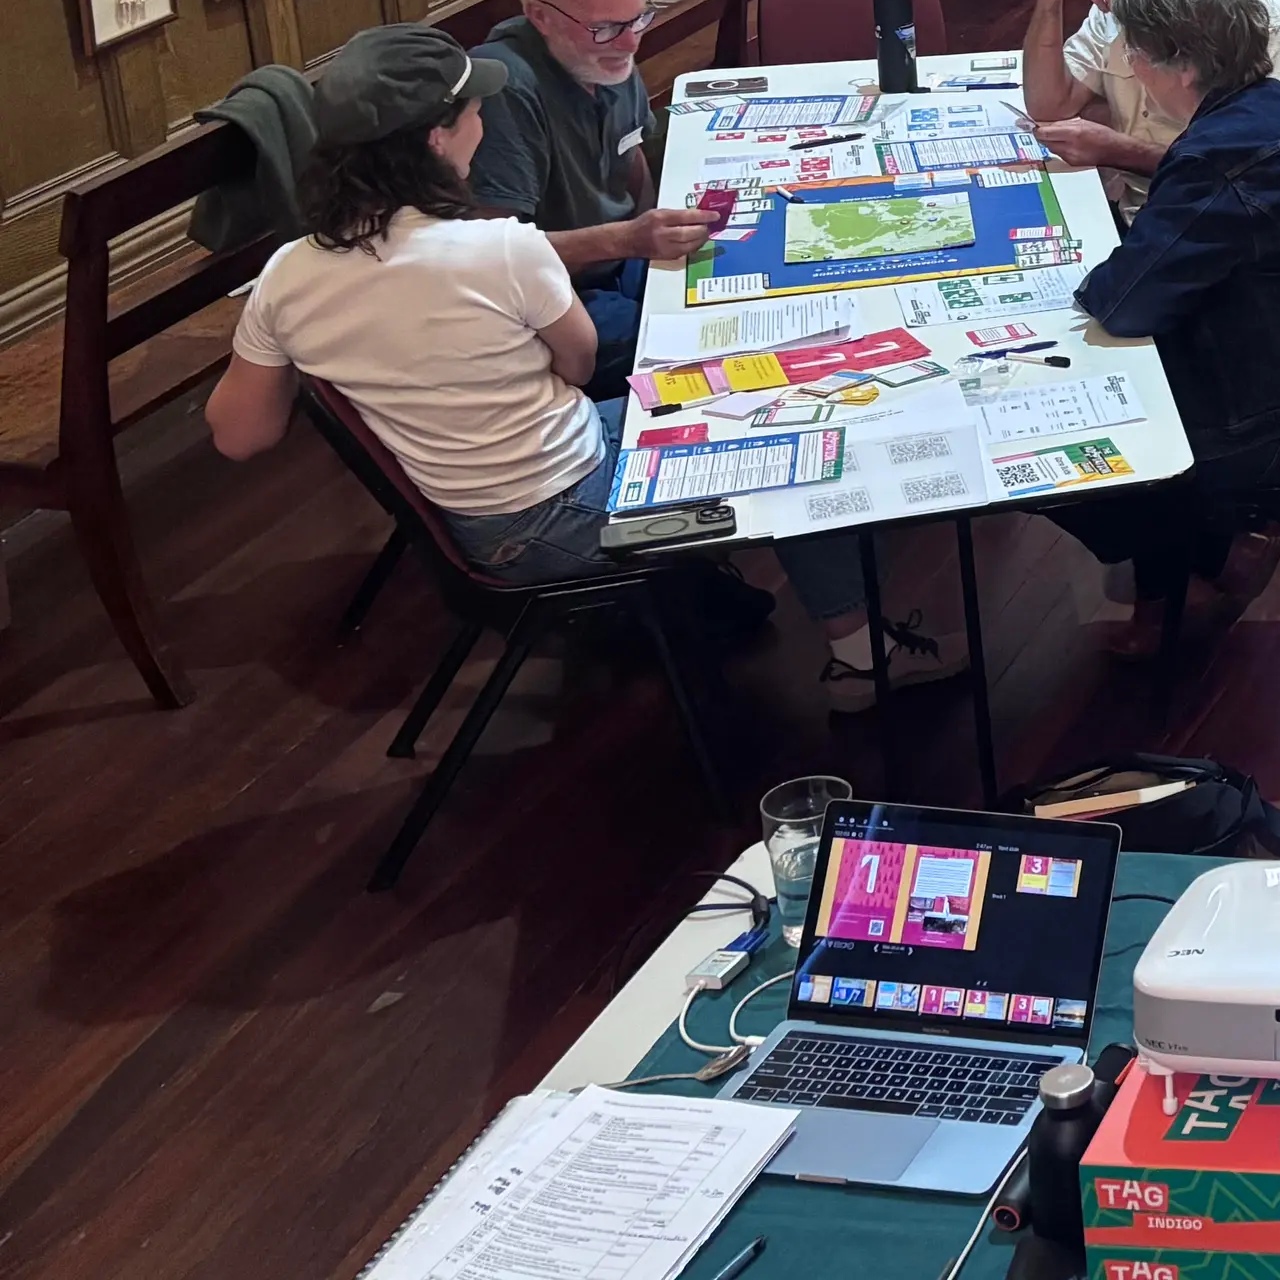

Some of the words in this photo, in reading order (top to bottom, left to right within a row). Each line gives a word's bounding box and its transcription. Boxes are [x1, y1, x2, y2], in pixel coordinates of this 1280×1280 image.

[860, 854, 881, 894] 1
[1167, 948, 1205, 958] NEC
[1144, 1038, 1166, 1050] NEC
[1101, 1180, 1164, 1211] TAG
[1146, 1216, 1203, 1231] INDIGO
[1110, 1261, 1173, 1280] TAG
